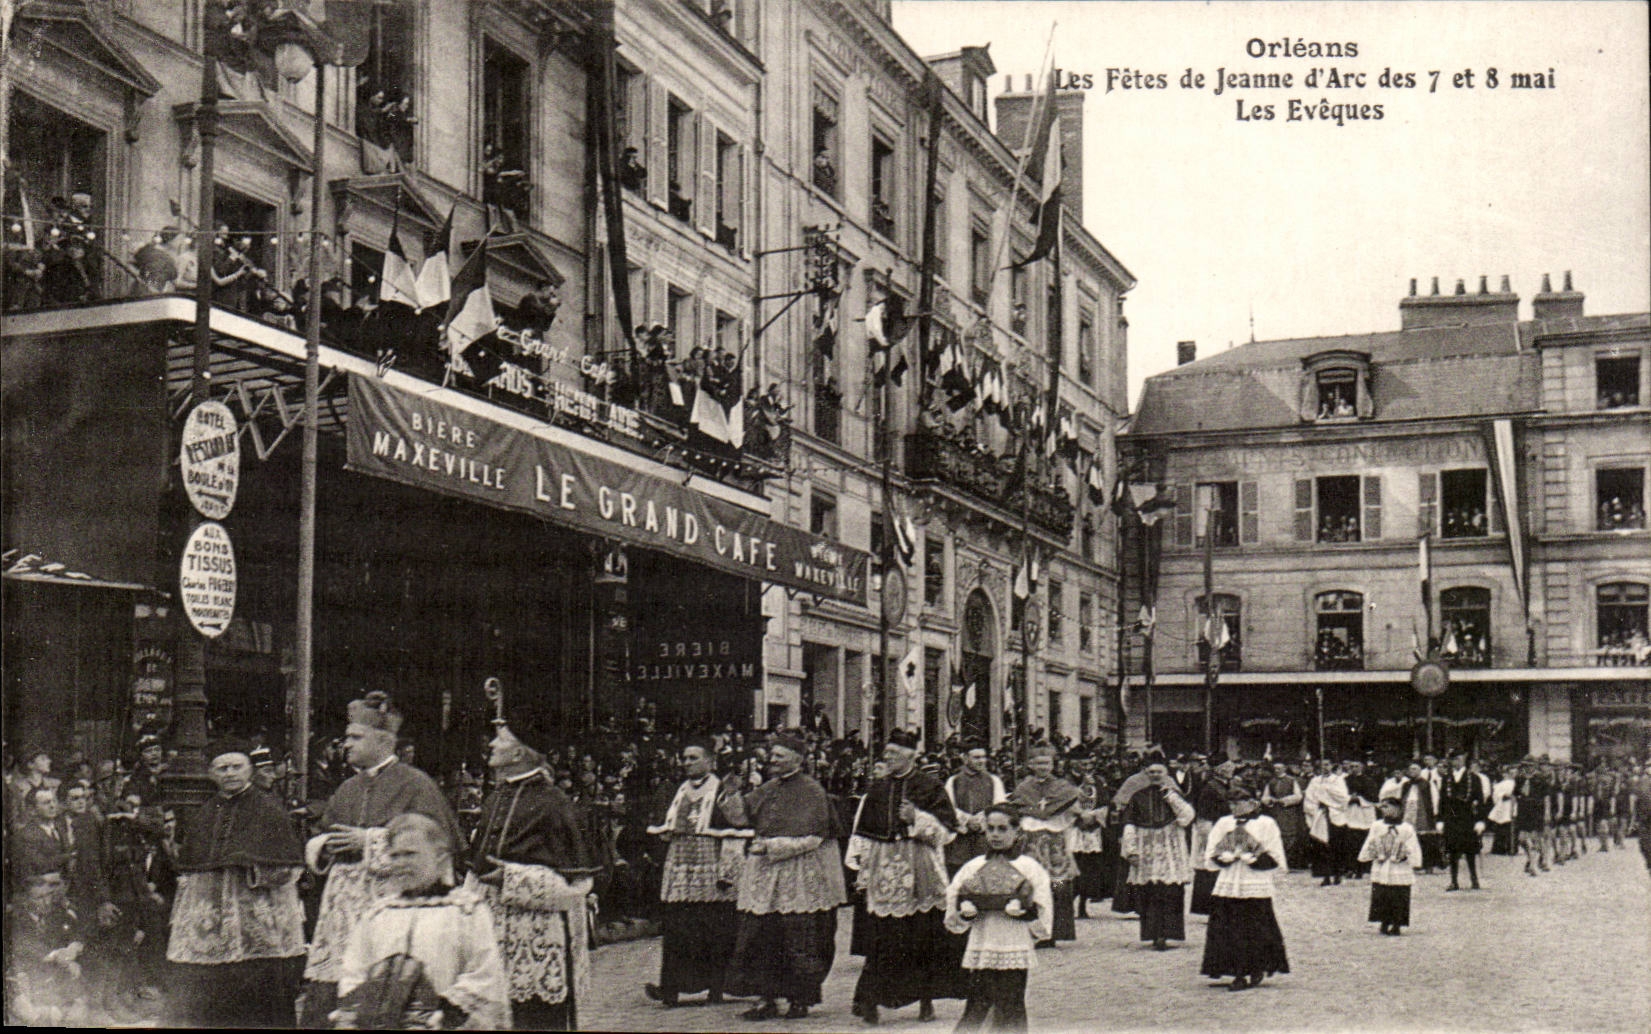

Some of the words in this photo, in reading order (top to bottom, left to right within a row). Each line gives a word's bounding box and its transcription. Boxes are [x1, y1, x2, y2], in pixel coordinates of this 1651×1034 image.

[372, 430, 507, 490] MAXEVILLE
[535, 464, 577, 511] LE
[598, 485, 700, 545] GRAND
[714, 523, 778, 572] CAFE
[186, 554, 233, 575] TISSUS
[194, 540, 229, 556] BONS
